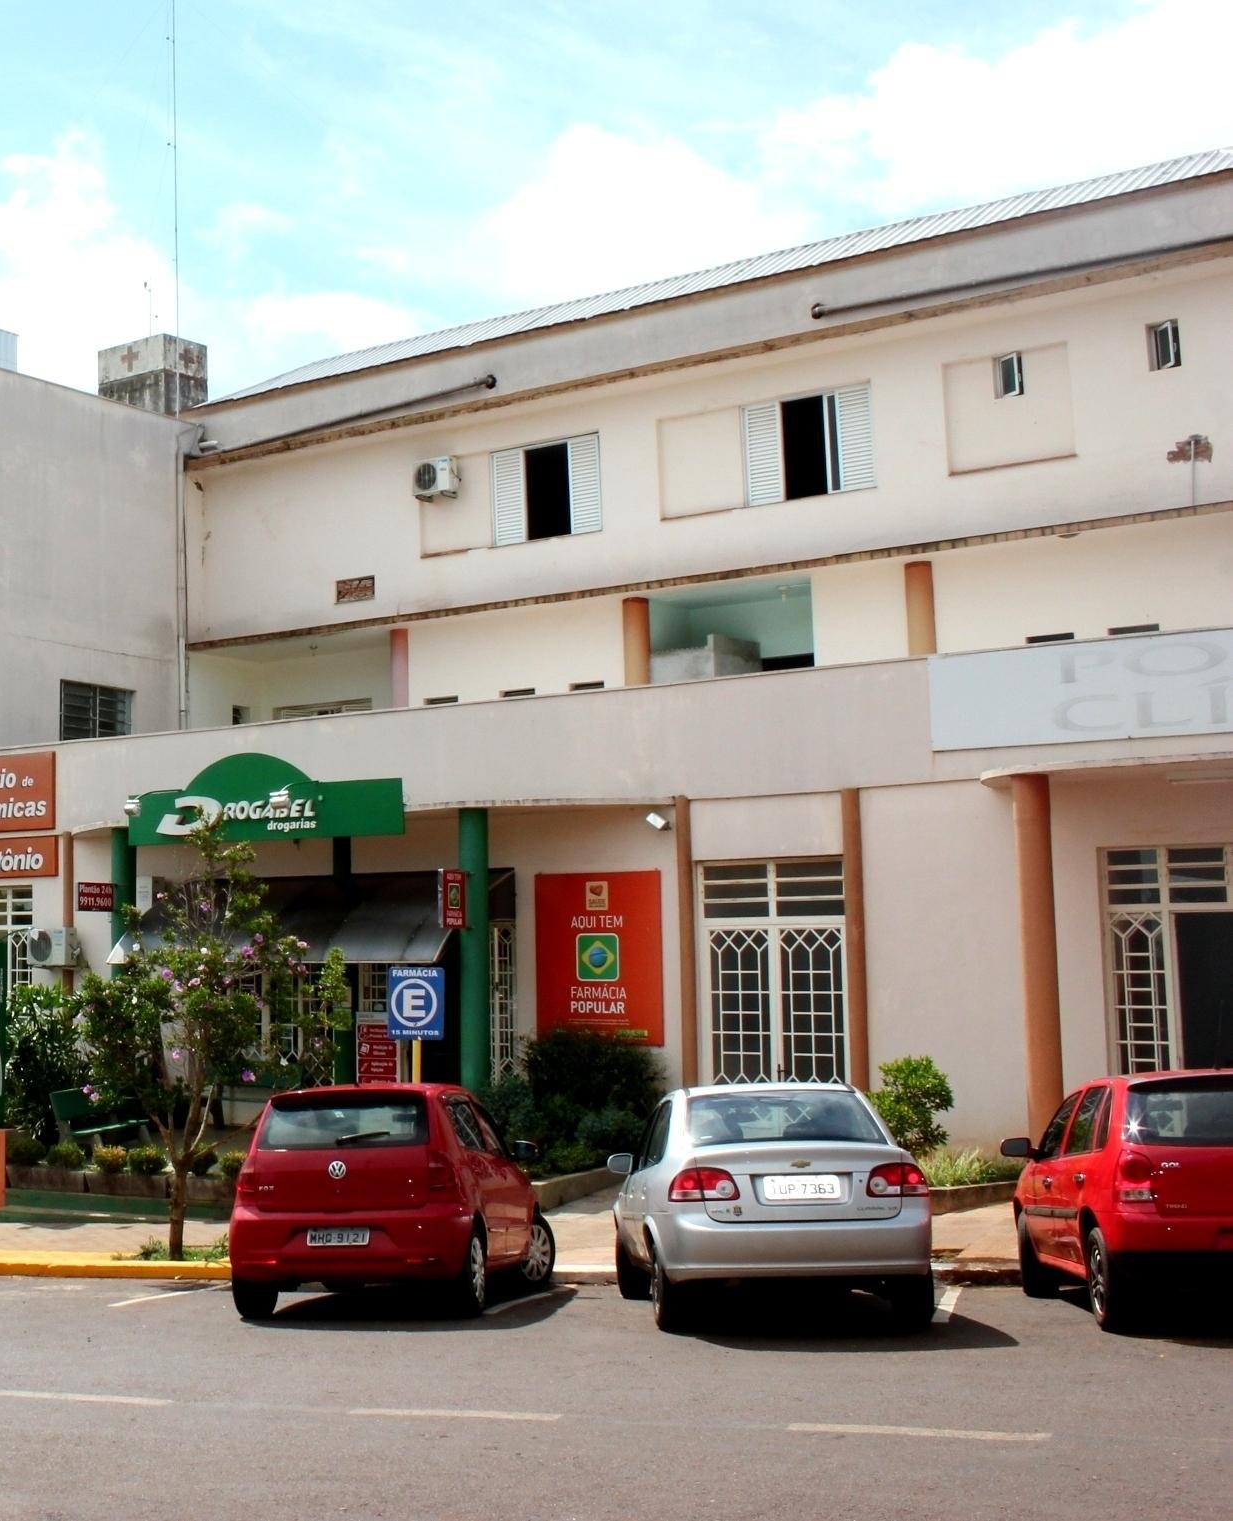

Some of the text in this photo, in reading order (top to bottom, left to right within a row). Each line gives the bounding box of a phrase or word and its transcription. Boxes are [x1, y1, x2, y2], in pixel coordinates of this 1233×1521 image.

[21, 776, 34, 787] de
[267, 818, 317, 833] drogarias
[79, 884, 101, 894] Plantão
[570, 915, 623, 929] AQUI TEM
[392, 968, 438, 977] FARMÁCIA
[570, 984, 627, 999] FARMÁCIA
[402, 988, 426, 1017] E
[570, 1001, 625, 1014] POPULAR
